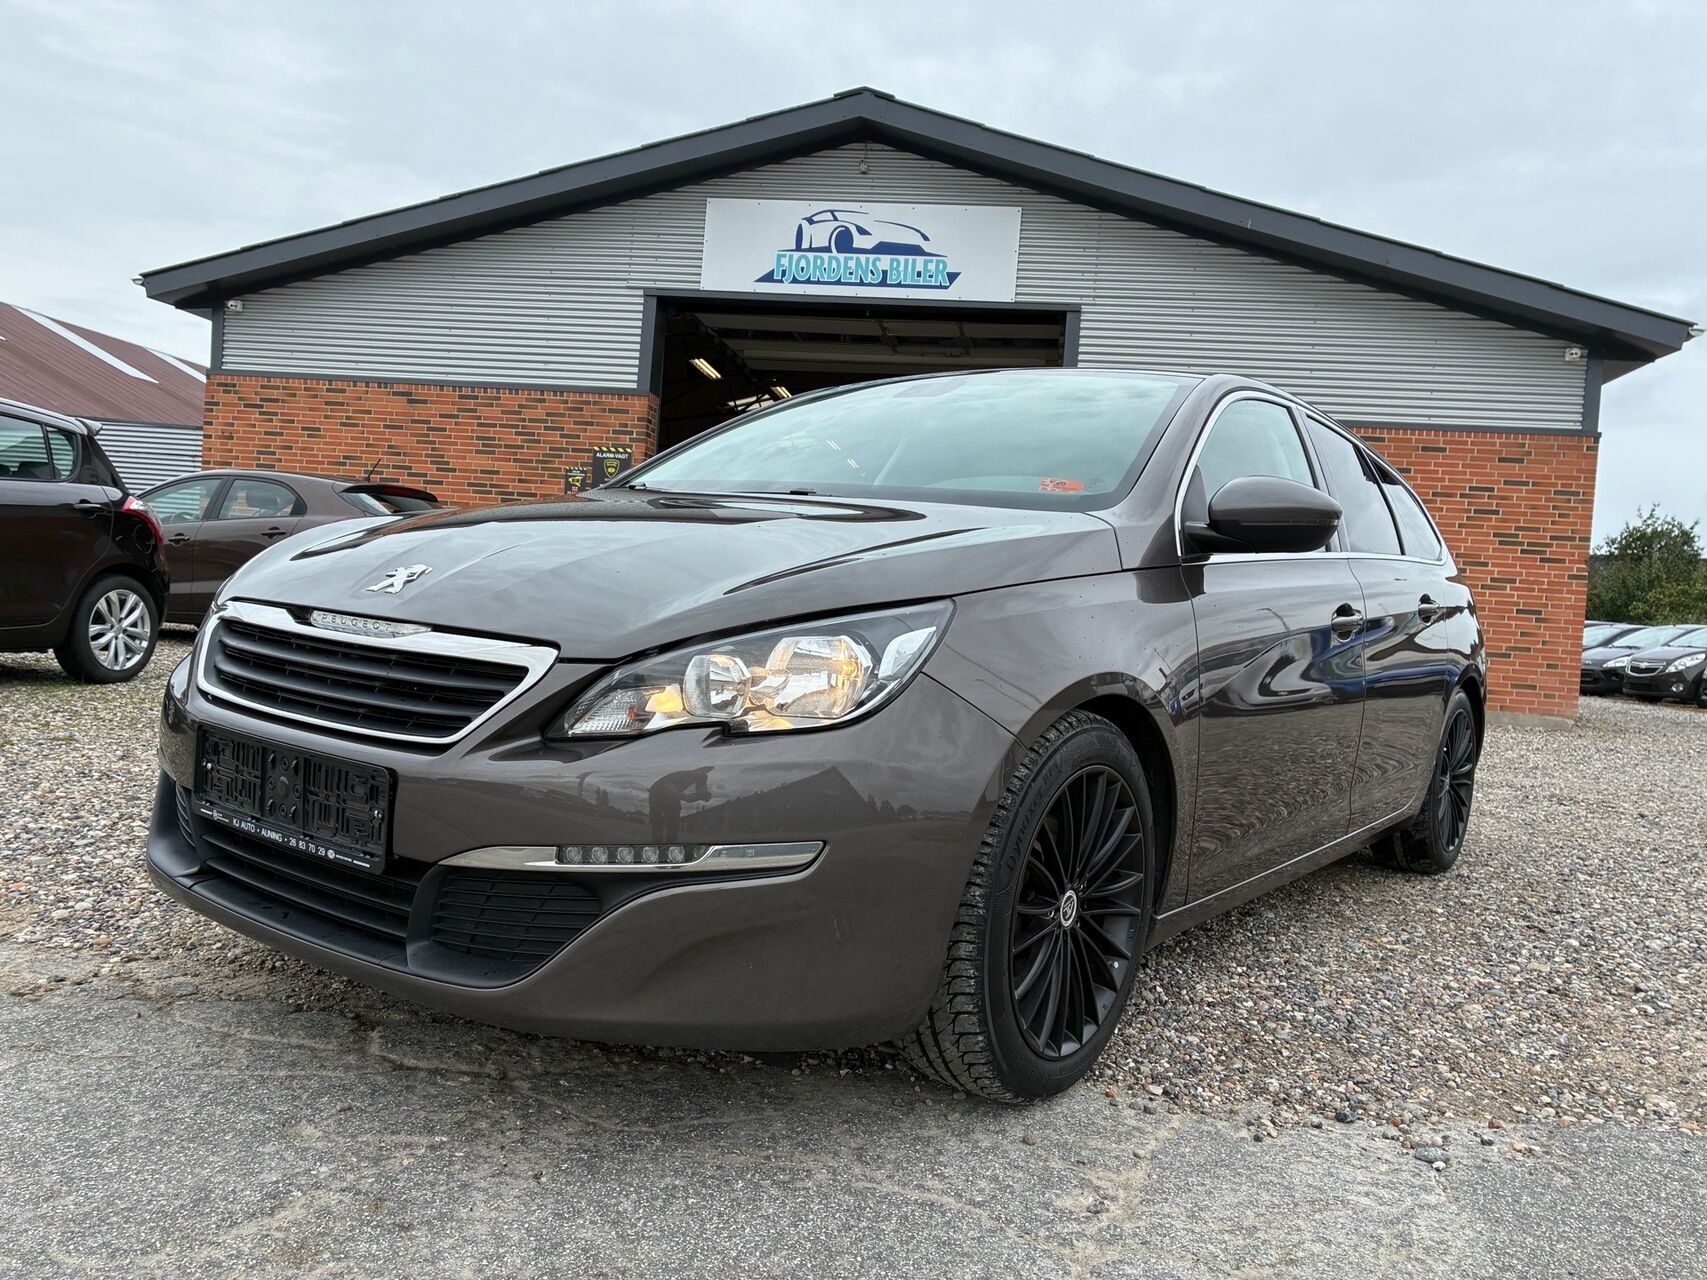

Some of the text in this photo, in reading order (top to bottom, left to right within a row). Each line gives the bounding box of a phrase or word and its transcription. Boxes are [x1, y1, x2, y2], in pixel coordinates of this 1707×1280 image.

[773, 253, 950, 286] FJORDENS BILER
[321, 613, 392, 632] PEUGEOT
[232, 817, 326, 856] KJ AUTO AUNING 26 83 70 29
